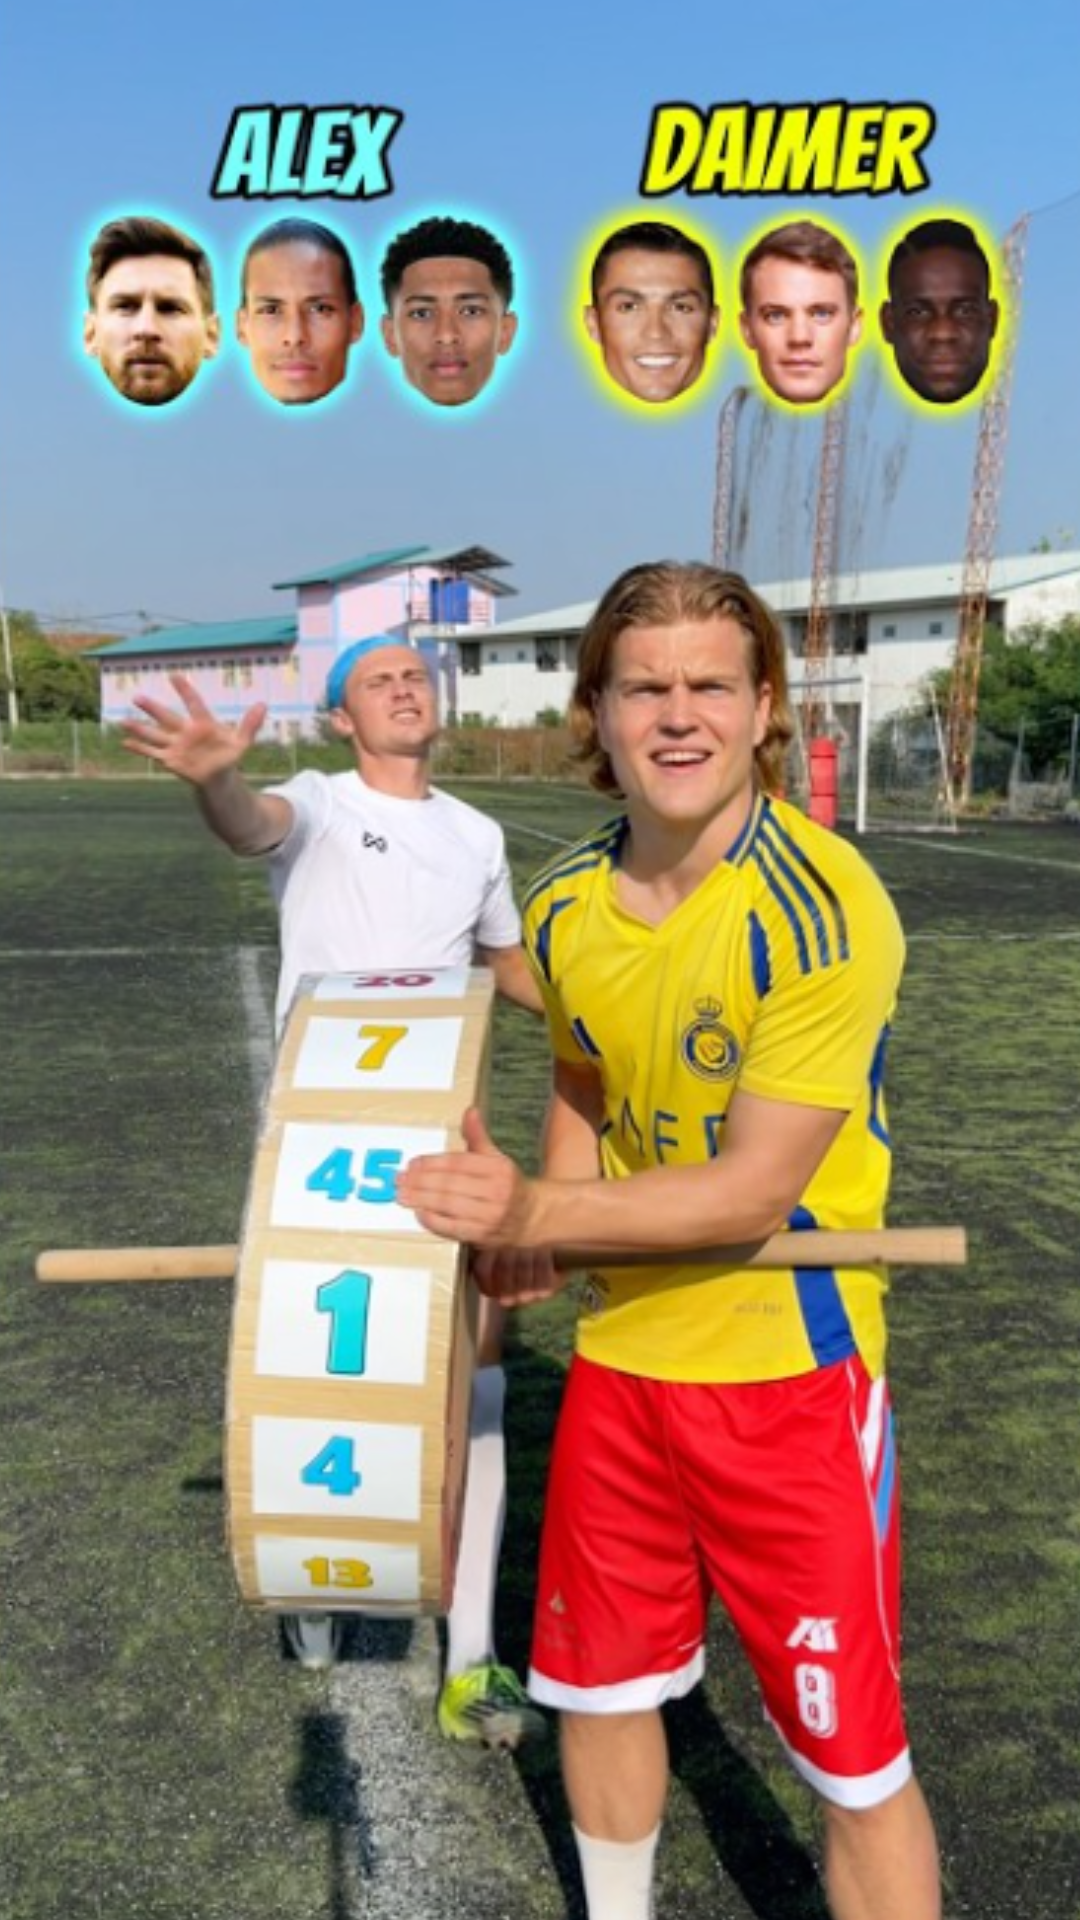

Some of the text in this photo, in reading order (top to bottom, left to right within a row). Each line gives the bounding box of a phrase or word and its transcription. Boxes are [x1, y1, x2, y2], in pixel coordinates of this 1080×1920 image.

[353, 974, 434, 989] 20
[355, 1024, 408, 1071] 7
[305, 1147, 403, 1204] 45
[316, 1269, 372, 1375] 1
[301, 1436, 361, 1495] 4
[303, 1556, 373, 1589] 13
[794, 1663, 838, 1738] 8
